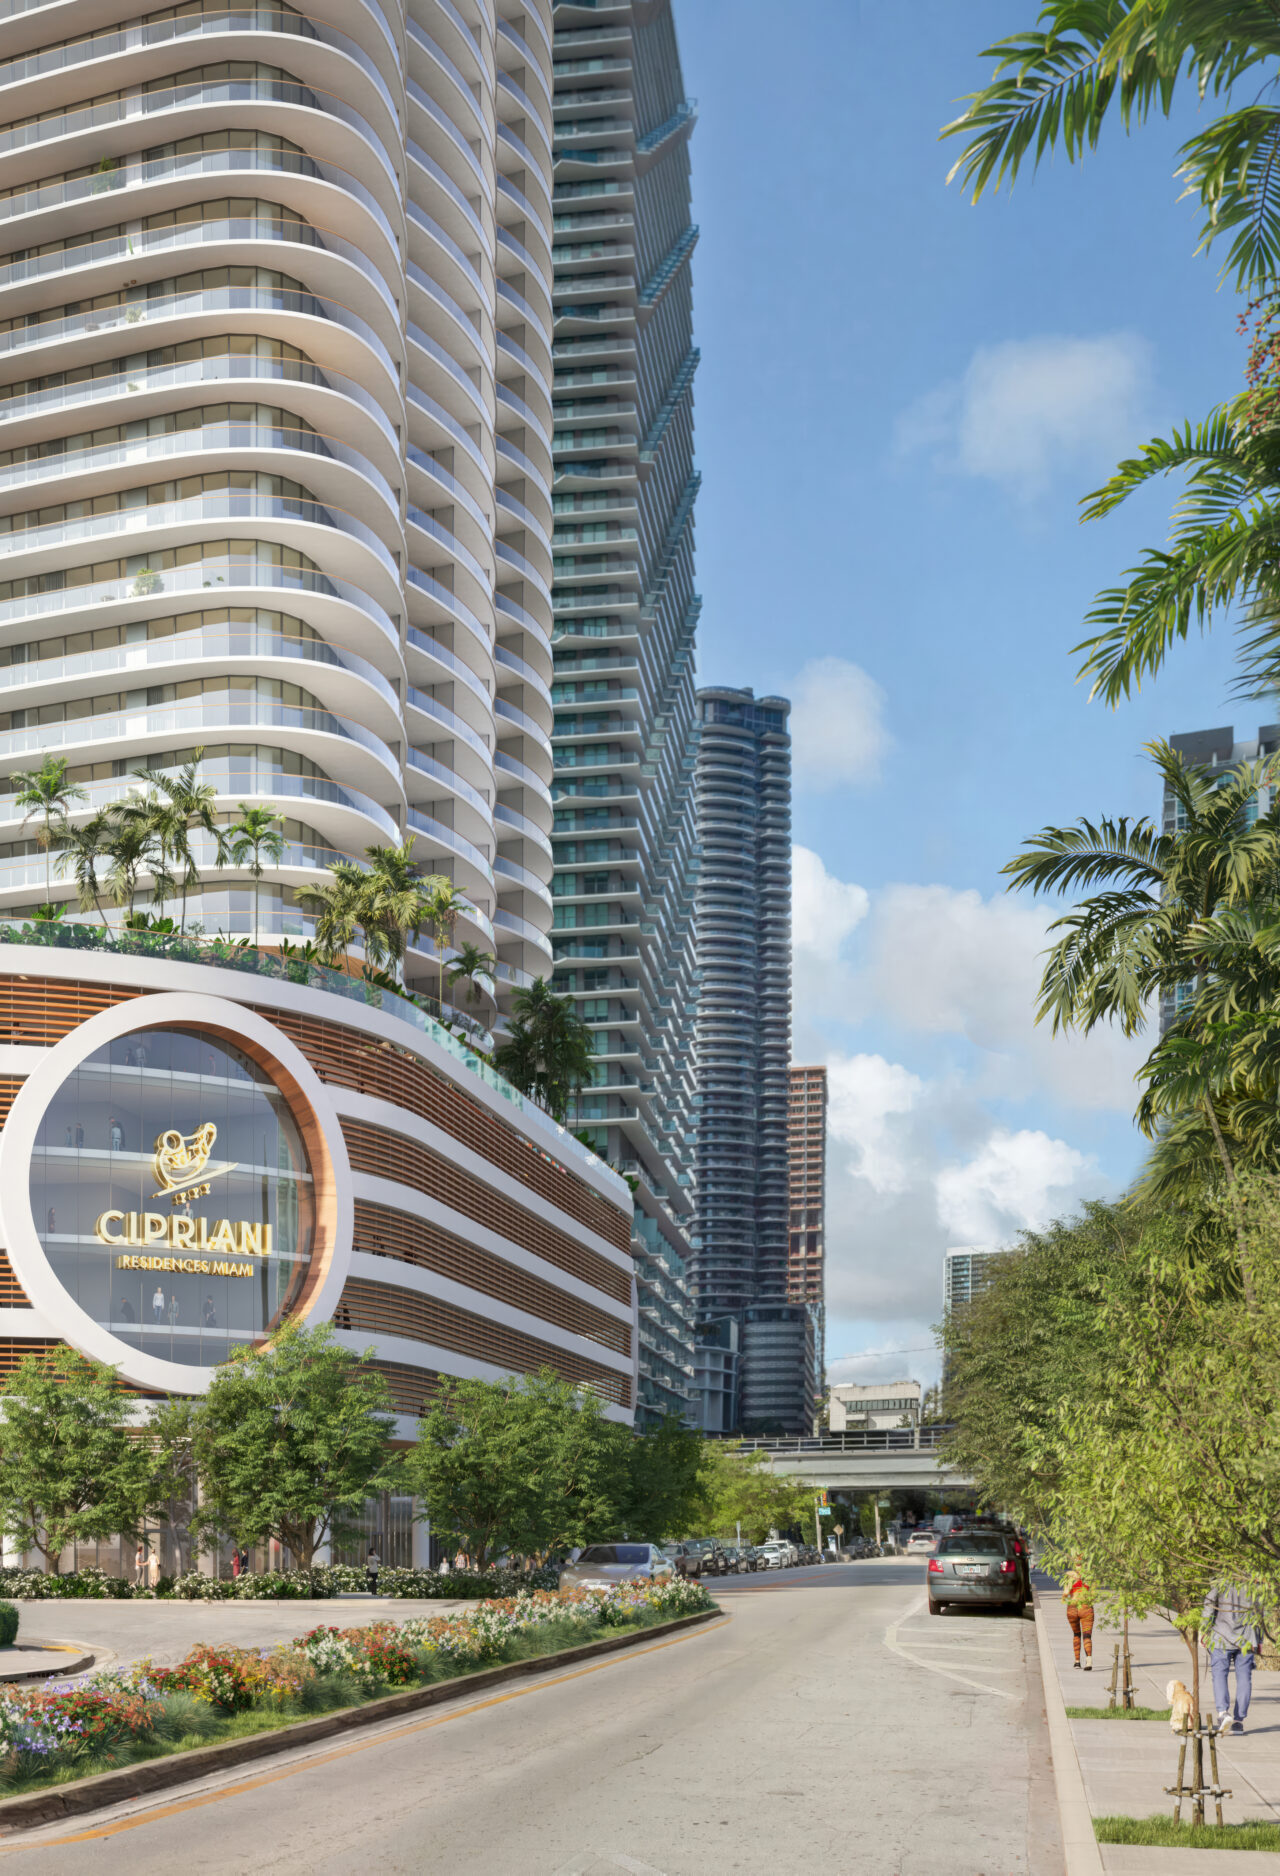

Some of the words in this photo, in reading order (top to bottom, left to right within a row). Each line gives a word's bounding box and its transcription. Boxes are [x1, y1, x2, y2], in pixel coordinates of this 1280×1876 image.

[96, 1210, 272, 1255] CIPRIANI
[118, 1255, 208, 1275] RESIDENCES
[211, 1260, 254, 1277] MIAMI
